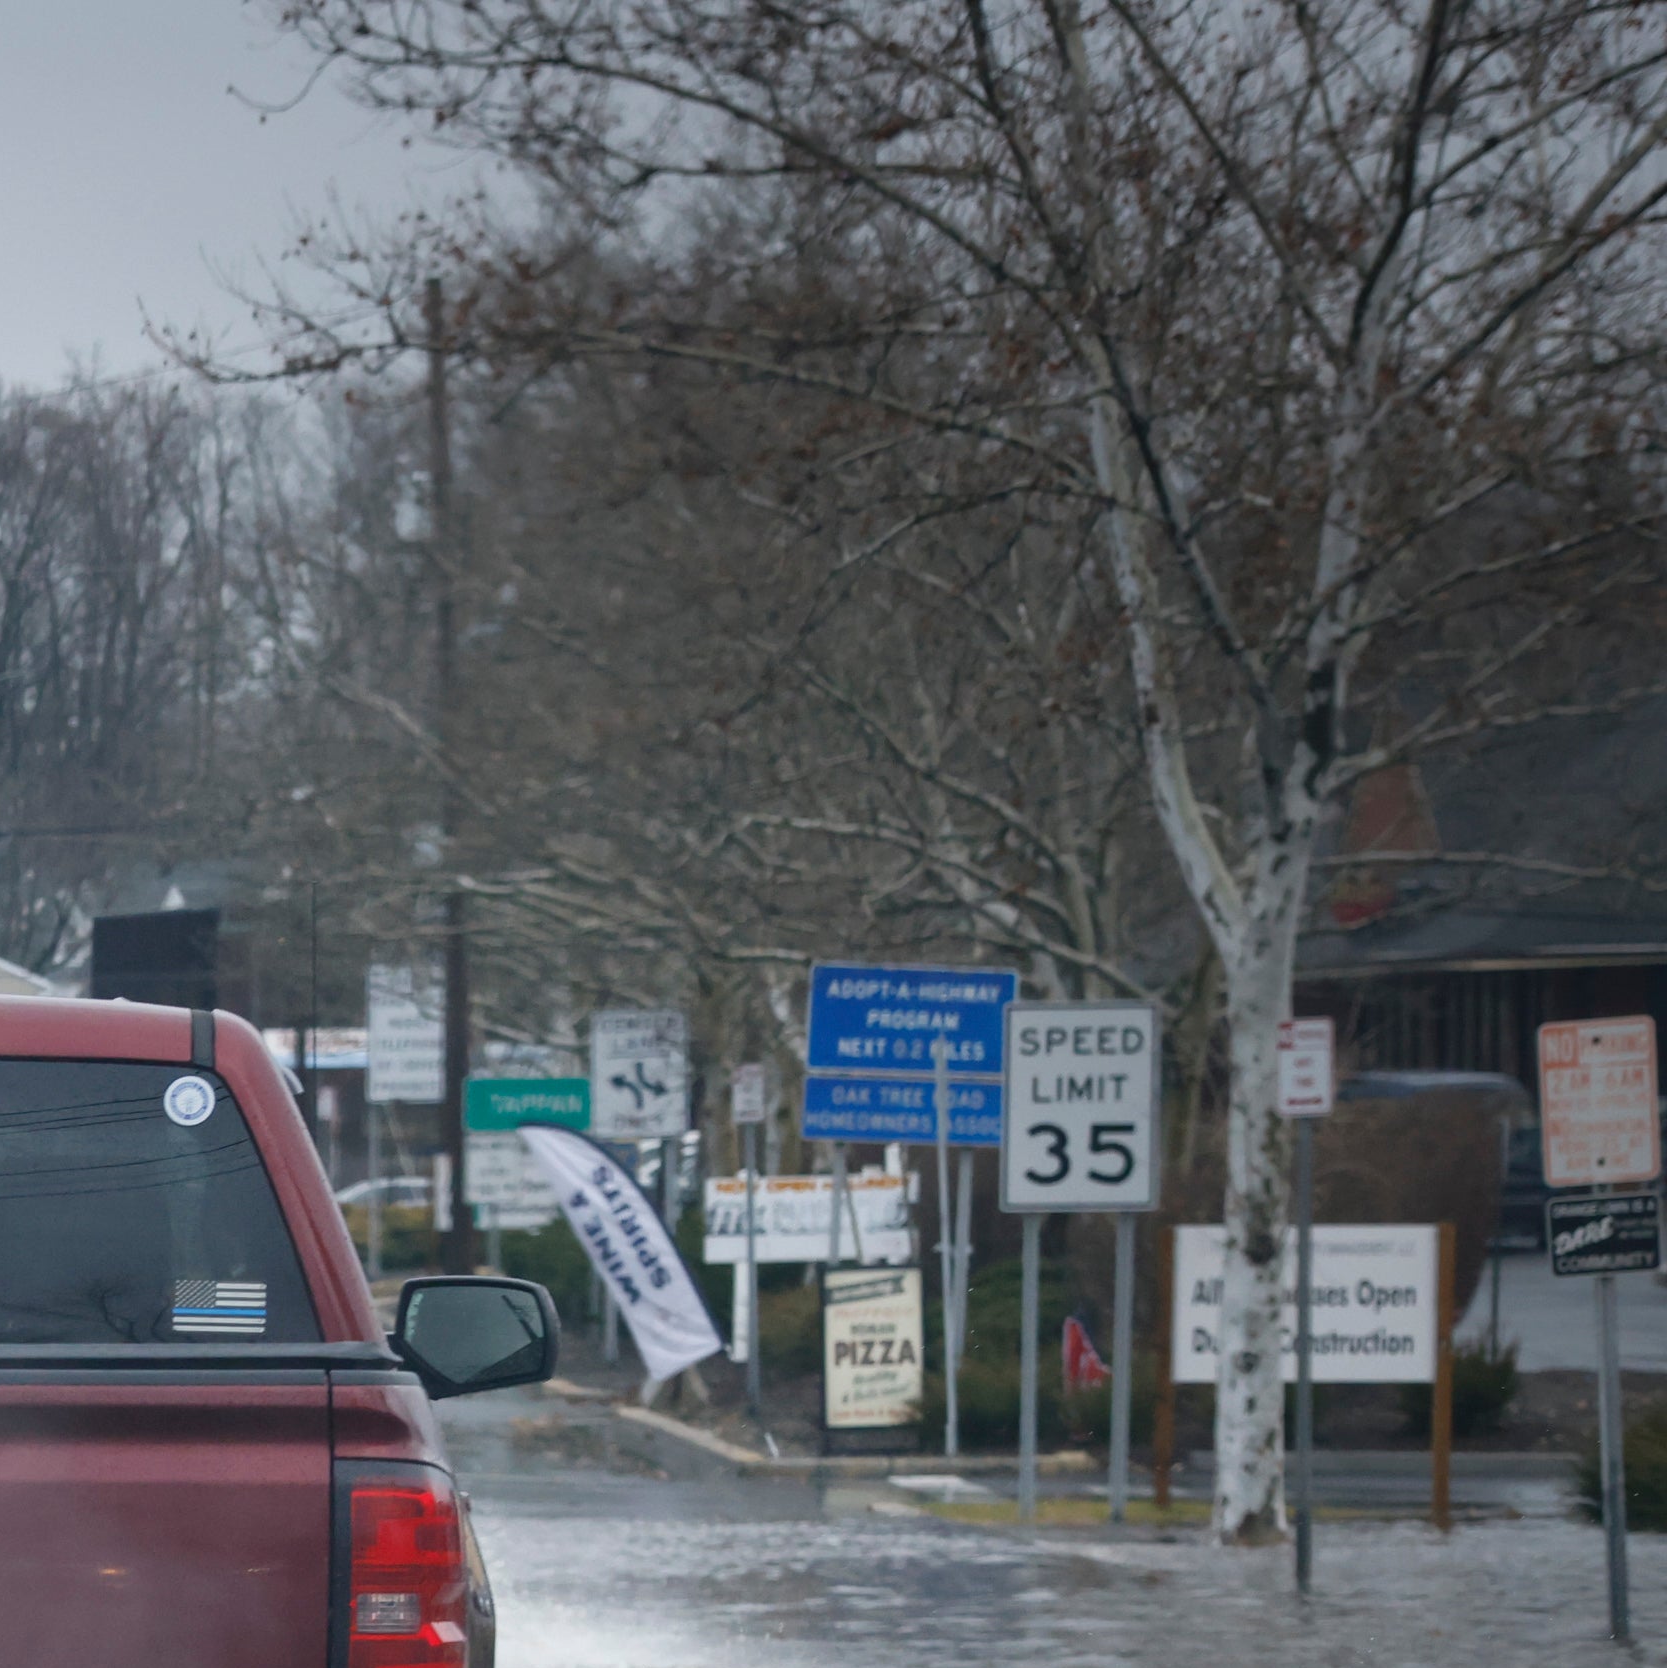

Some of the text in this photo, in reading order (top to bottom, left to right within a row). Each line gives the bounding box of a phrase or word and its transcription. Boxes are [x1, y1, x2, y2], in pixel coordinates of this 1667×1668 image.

[866, 1008, 960, 1031] PROGRAM
[838, 1037, 887, 1058] NEXT
[1020, 1025, 1144, 1056] SPEED
[831, 1085, 871, 1105] OAK
[879, 1086, 924, 1108] TREE
[1031, 1073, 1129, 1104] LIMIT
[1024, 1122, 1138, 1186] 35
[1355, 1278, 1417, 1314] Open
[833, 1338, 916, 1367] PIZZA
